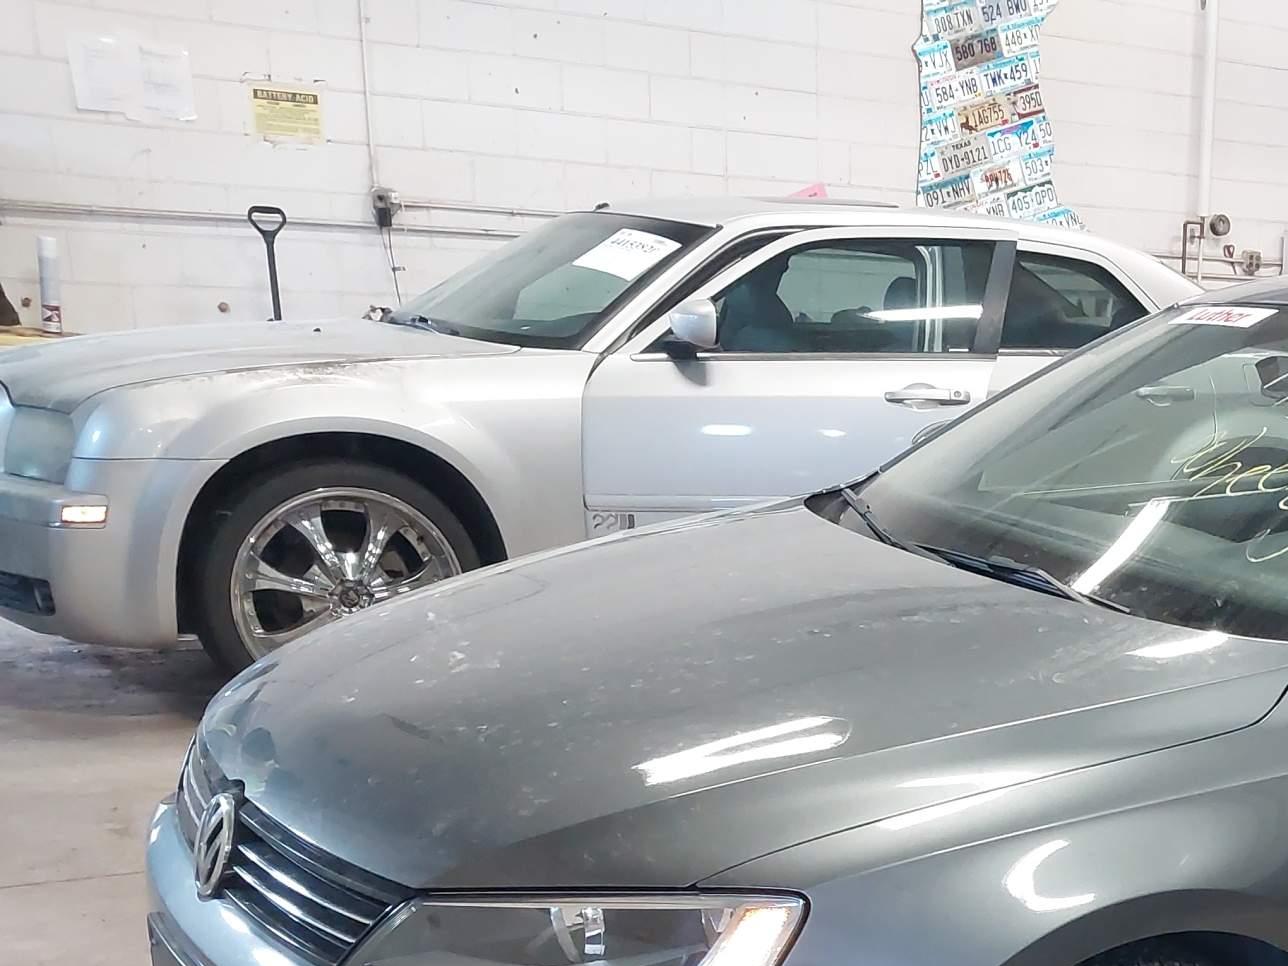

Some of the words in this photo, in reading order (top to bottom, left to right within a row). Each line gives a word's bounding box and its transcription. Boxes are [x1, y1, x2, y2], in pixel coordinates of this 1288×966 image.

[257, 89, 292, 101] BATTERY
[296, 93, 314, 103] ACID
[950, 140, 972, 151] TEXAS
